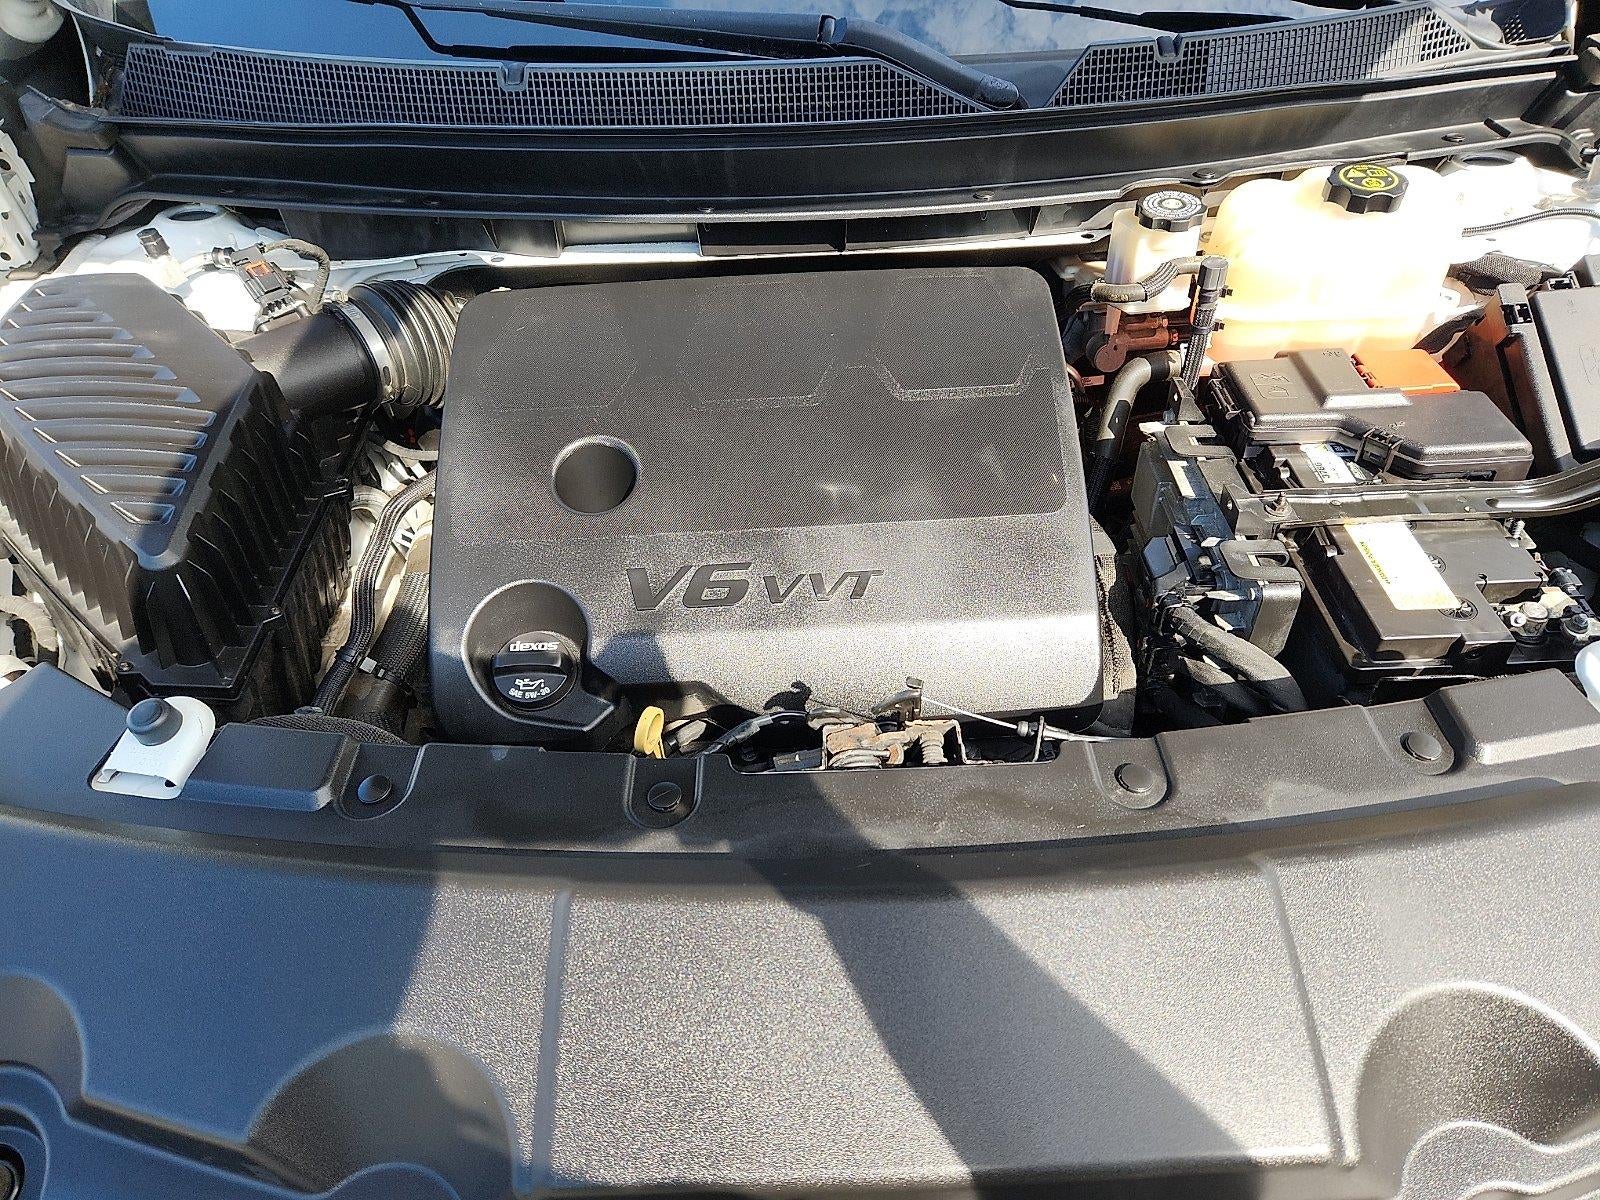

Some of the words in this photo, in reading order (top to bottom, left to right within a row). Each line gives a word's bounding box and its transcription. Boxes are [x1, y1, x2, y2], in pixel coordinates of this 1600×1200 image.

[626, 562, 753, 611] V6
[762, 569, 883, 604] VVT
[509, 640, 560, 652] dexos
[508, 687, 523, 698] SAE
[524, 686, 551, 699] 5W-30
